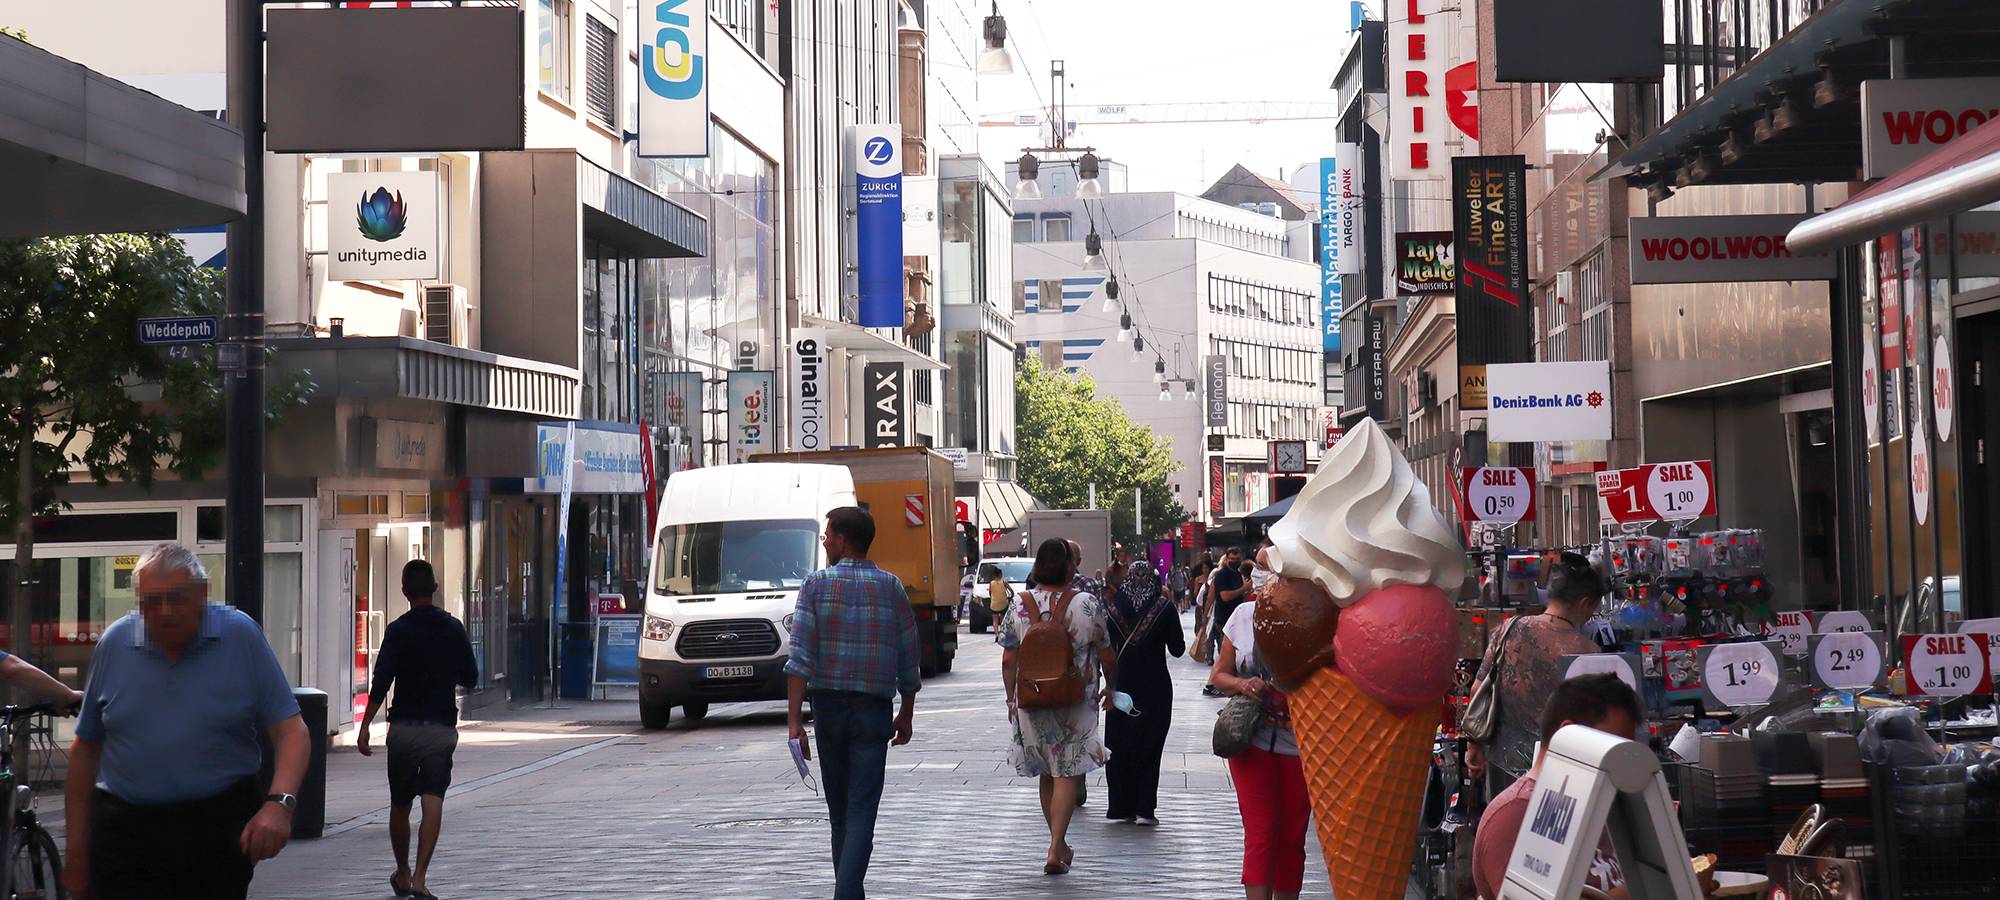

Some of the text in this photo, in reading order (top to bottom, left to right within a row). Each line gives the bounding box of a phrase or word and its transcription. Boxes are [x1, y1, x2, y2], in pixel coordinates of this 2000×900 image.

[1882, 108, 1999, 145] WOO
[862, 182, 897, 191] ZURICH
[1508, 171, 1517, 199] SPAREN
[1342, 168, 1353, 249] TARGO BANK
[1466, 169, 1483, 247] Juwelier
[1509, 200, 1517, 211] ZU
[1485, 168, 1505, 266] Fine ART
[1510, 213, 1518, 232] GELD
[1510, 233, 1518, 248] ART
[1641, 236, 1794, 261] WOOLWOR
[338, 247, 427, 266] unitymedia
[1322, 172, 1341, 335] Ruhr Nachrichten
[1404, 239, 1435, 262] Taj
[1402, 260, 1455, 282] Maha
[1417, 282, 1449, 290] INDISCHES
[145, 321, 211, 338] Weddepoth
[1373, 320, 1382, 349] RAW
[169, 345, 188, 358] 4-2
[1464, 375, 1487, 388] AN
[796, 339, 823, 450] ginatrico
[1493, 395, 1562, 409] DenizBank
[1565, 394, 1583, 408] AG
[1482, 469, 1517, 486] SALE
[1598, 473, 1619, 481] SUPER
[1659, 464, 1694, 483] SALE
[1485, 495, 1515, 515] 0.50
[1664, 490, 1694, 512] 1.00
[1776, 612, 1801, 627] SALE
[1926, 636, 1966, 655] SALE
[1829, 648, 1864, 671] 2.49
[732, 666, 753, 676] 1138
[1722, 660, 1761, 687] 1.99
[1923, 665, 1970, 688] ab 1.00
